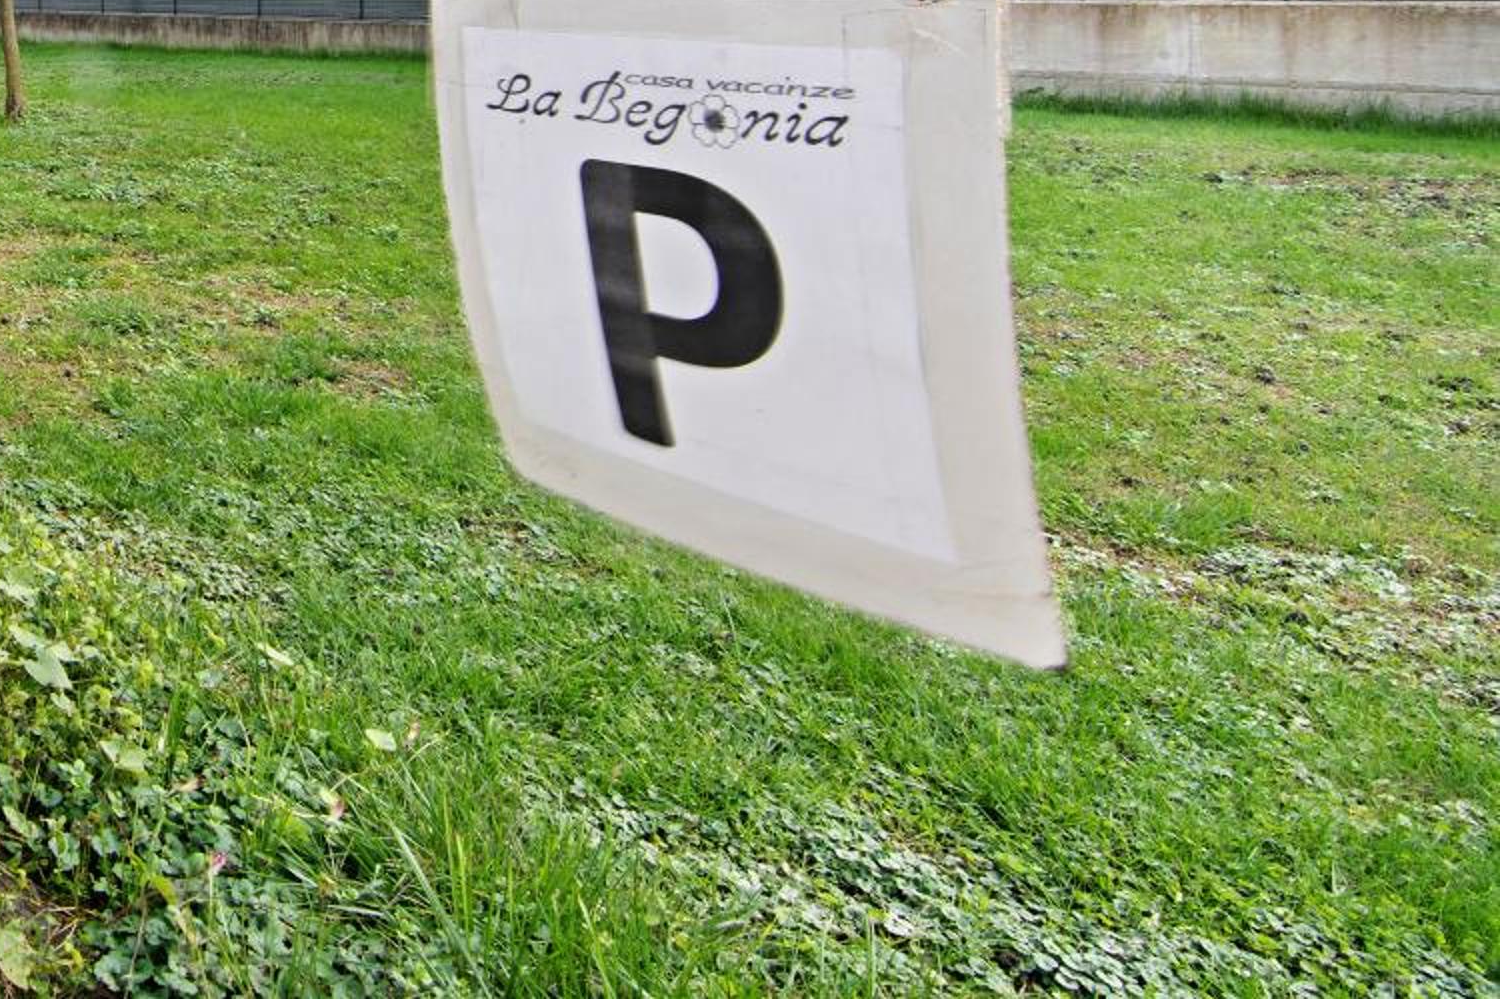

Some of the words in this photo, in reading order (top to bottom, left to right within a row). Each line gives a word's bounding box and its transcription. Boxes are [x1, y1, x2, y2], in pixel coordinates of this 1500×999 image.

[486, 73, 562, 117] La
[623, 73, 695, 90] casa
[706, 76, 856, 100] vacanze
[580, 158, 784, 448] P
